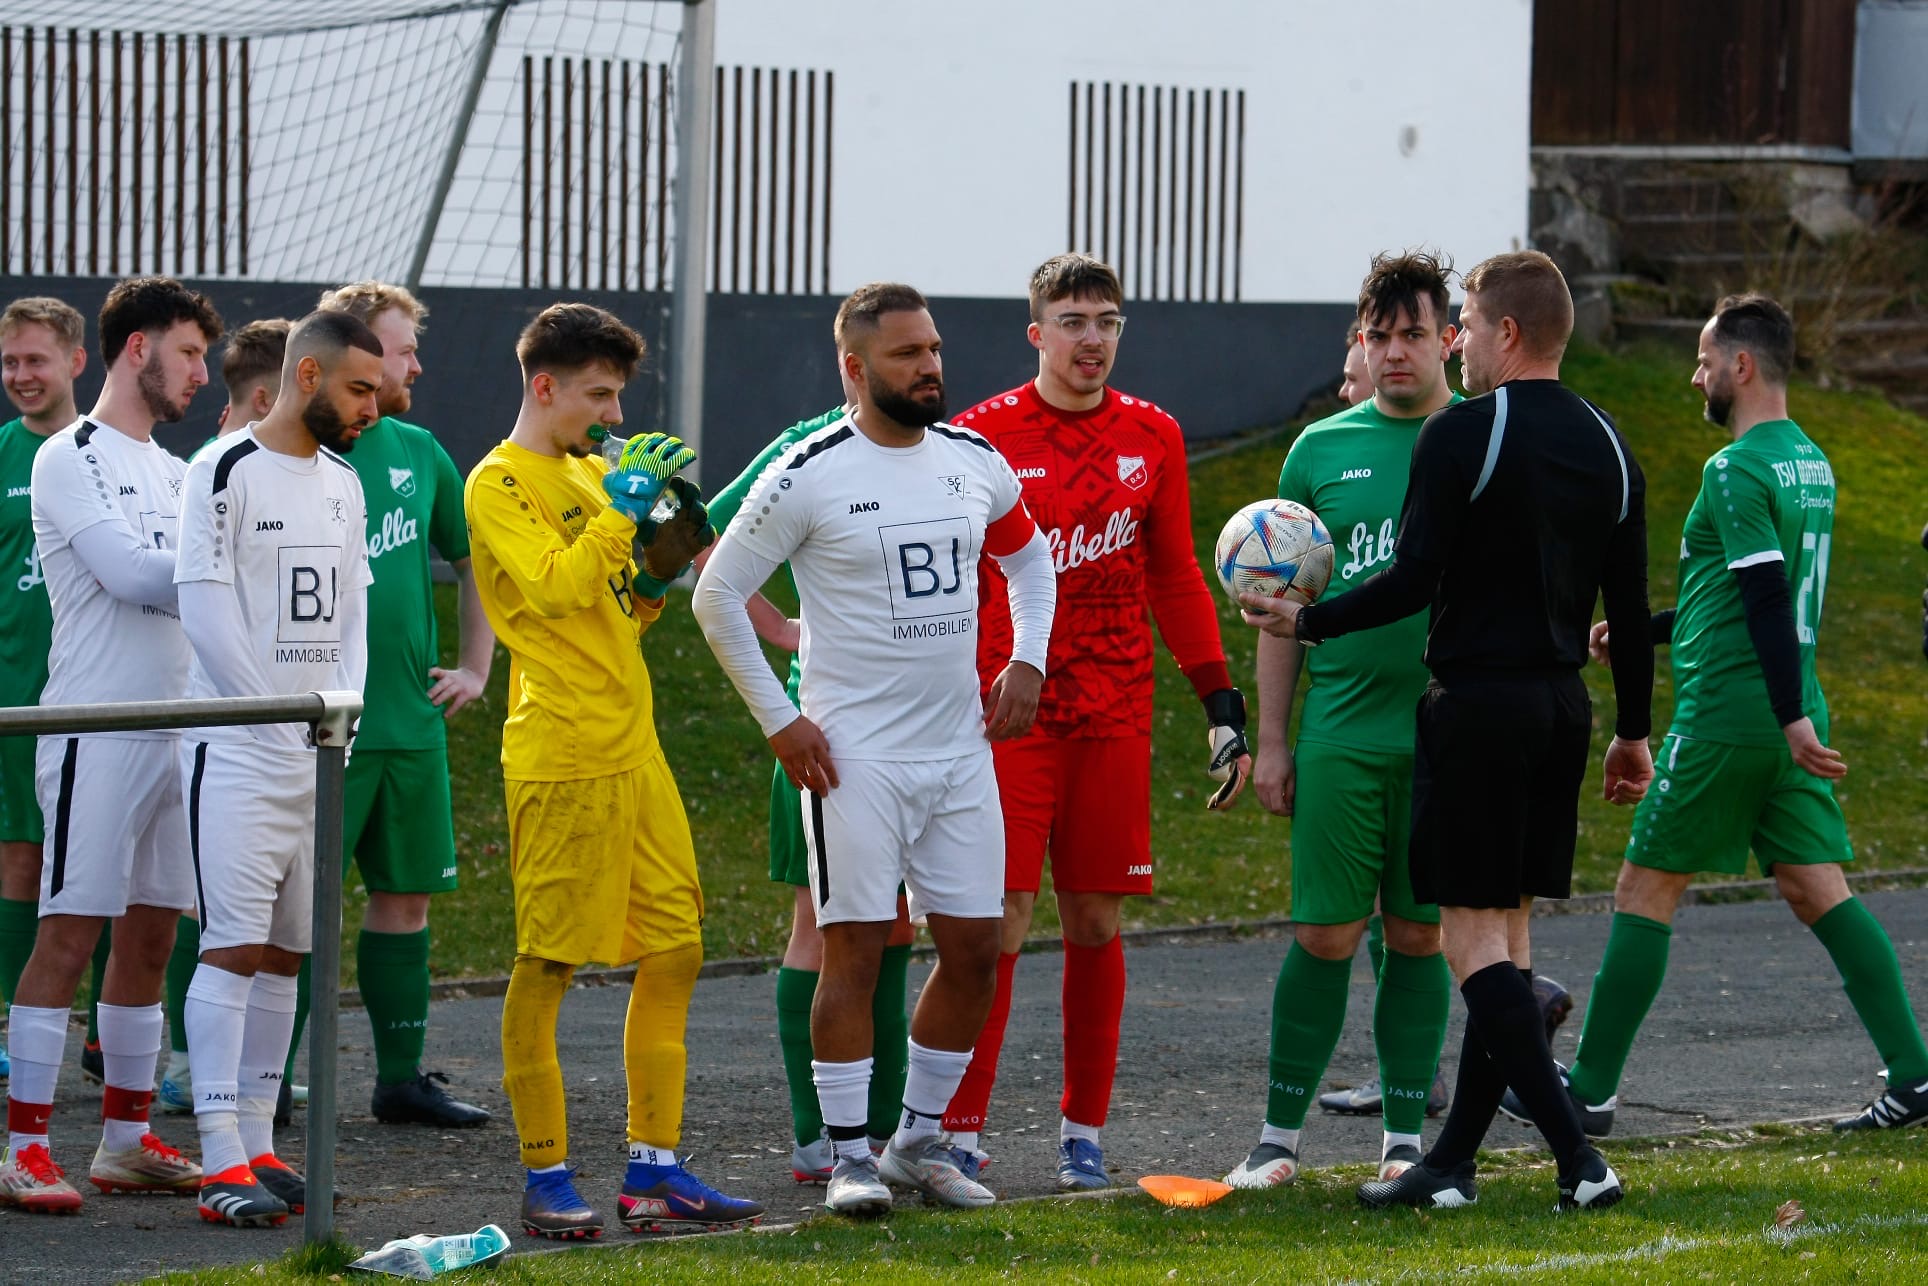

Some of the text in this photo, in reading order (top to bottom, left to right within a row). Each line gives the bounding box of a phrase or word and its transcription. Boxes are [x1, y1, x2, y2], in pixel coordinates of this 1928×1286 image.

[1017, 467, 1046, 479] JAKO
[1341, 468, 1372, 480] JAKO
[1771, 460, 1797, 489] TSV
[119, 485, 137, 496] JAK
[849, 501, 880, 515] JAKO
[255, 520, 284, 532] JAKO
[367, 506, 418, 558] ella
[1341, 518, 1395, 580] Lib
[898, 537, 961, 599] BJ
[291, 566, 336, 623] BJ
[1796, 532, 1830, 645] 21
[893, 617, 973, 640] IMMOBILIEN
[1127, 864, 1152, 876] JAKO
[1269, 1079, 1305, 1096] JAKO
[1387, 1086, 1425, 1100] JAKO
[205, 1092, 236, 1102] JAKO
[943, 1115, 980, 1125] JAKO
